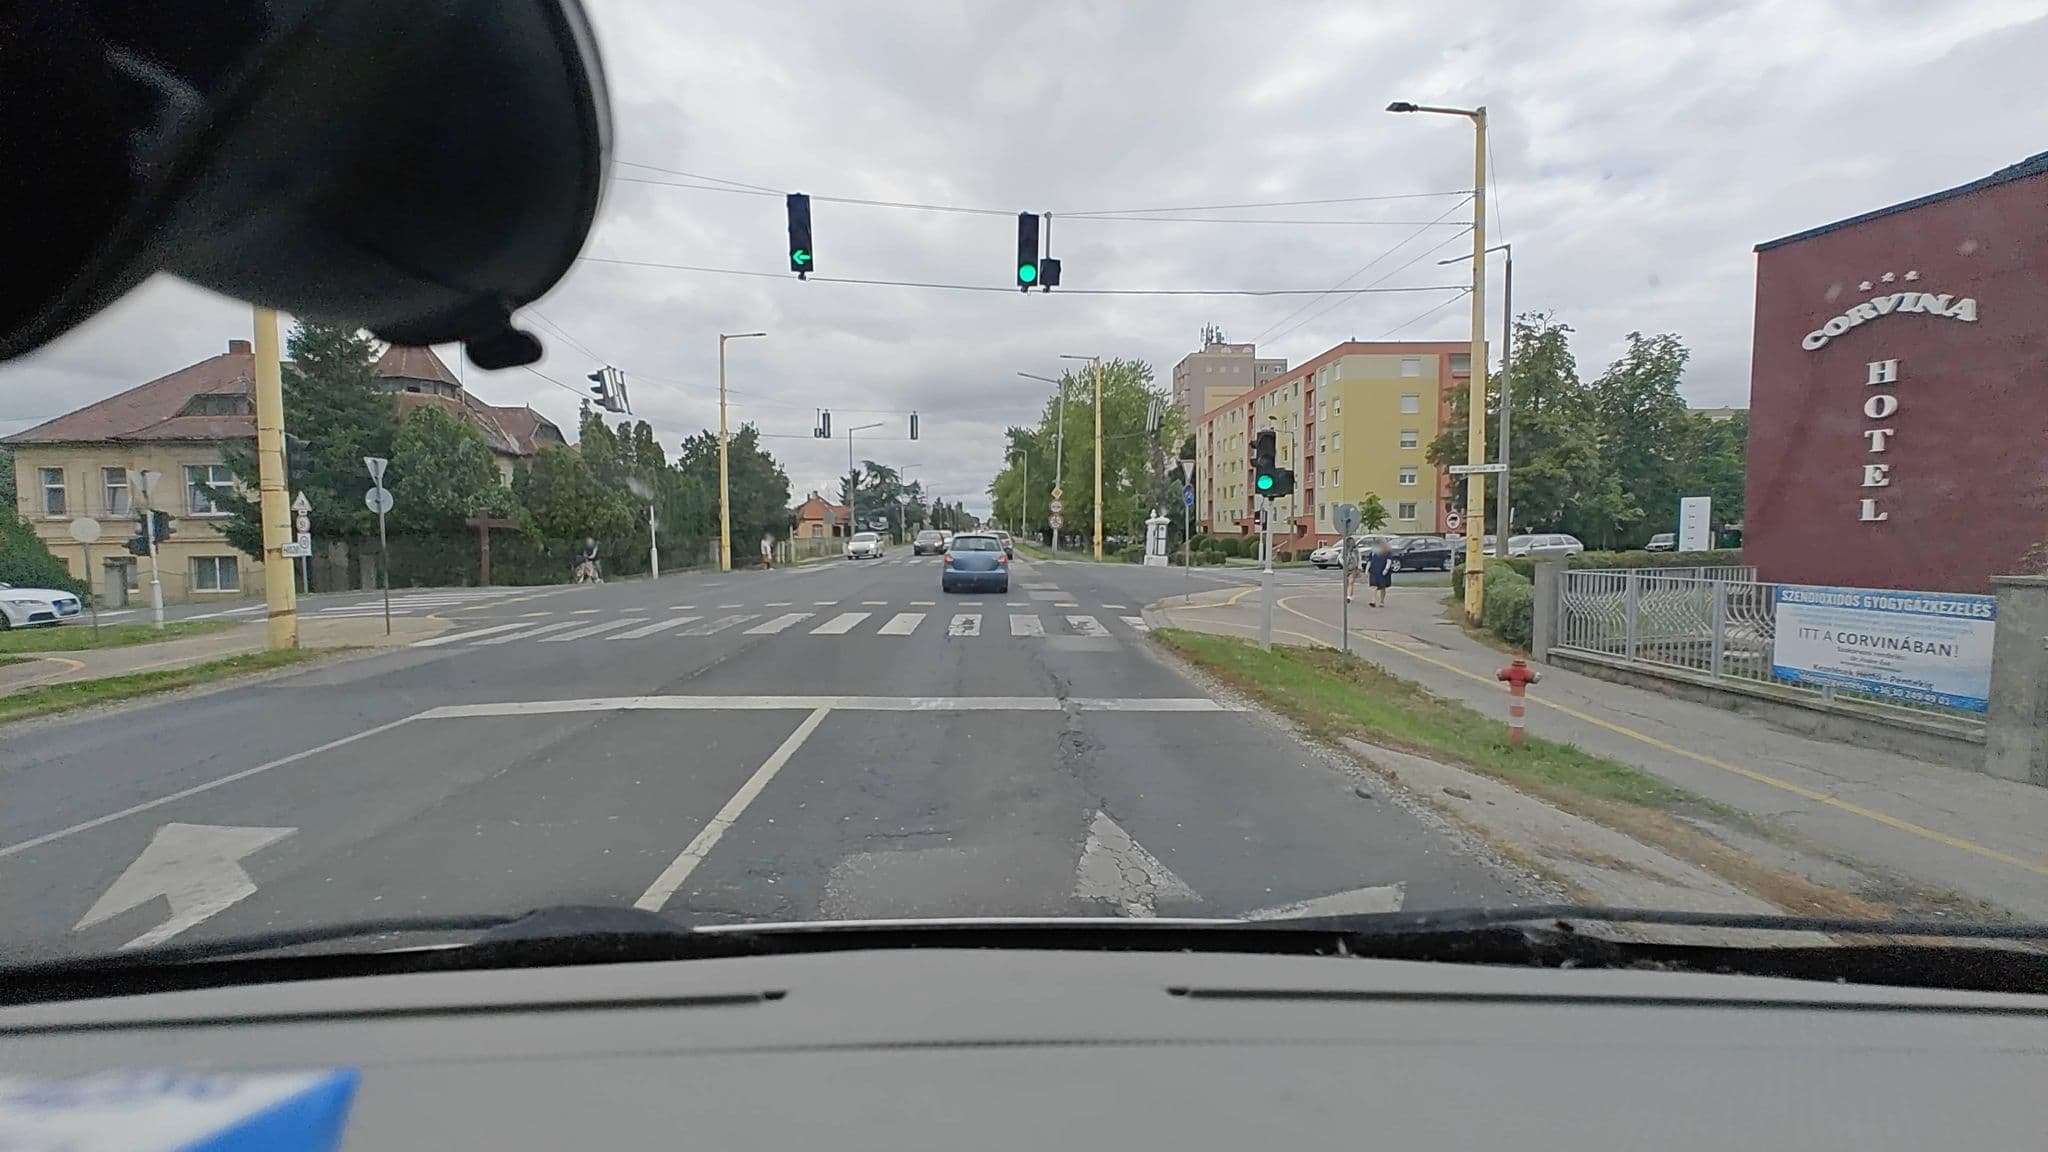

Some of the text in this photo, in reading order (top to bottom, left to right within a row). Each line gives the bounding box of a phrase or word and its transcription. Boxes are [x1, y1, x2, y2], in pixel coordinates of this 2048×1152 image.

[1801, 292, 1978, 350] CORVINA
[1859, 358, 1900, 522] HOTEL
[1799, 627, 1820, 641] ITT
[1823, 630, 1833, 642] A
[1836, 632, 1959, 658] CORVINÁBAN!
